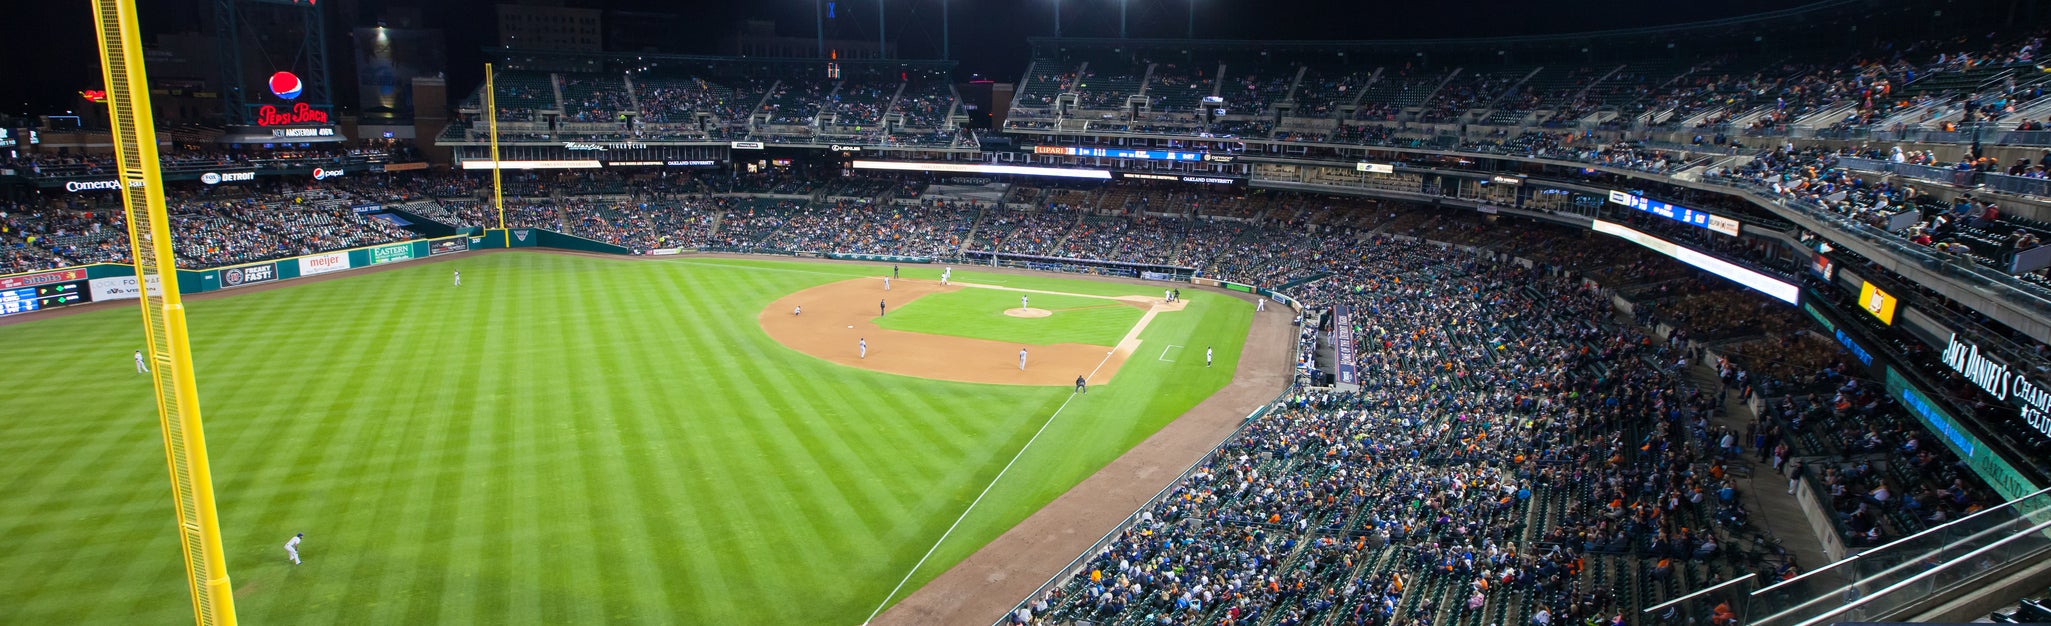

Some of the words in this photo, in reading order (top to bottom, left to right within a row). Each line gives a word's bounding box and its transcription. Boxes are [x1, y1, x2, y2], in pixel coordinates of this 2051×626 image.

[258, 105, 291, 126] PEPSI
[292, 102, 327, 124] PORCH
[222, 172, 255, 182] DETROIT
[324, 168, 344, 178] pepsi
[374, 245, 409, 257] EASTERN
[310, 255, 339, 267] meijer
[245, 264, 272, 273] FREAKY
[245, 271, 273, 281] FAST!
[1942, 332, 1969, 373] JACK
[1964, 344, 2011, 401] DANIEL'S
